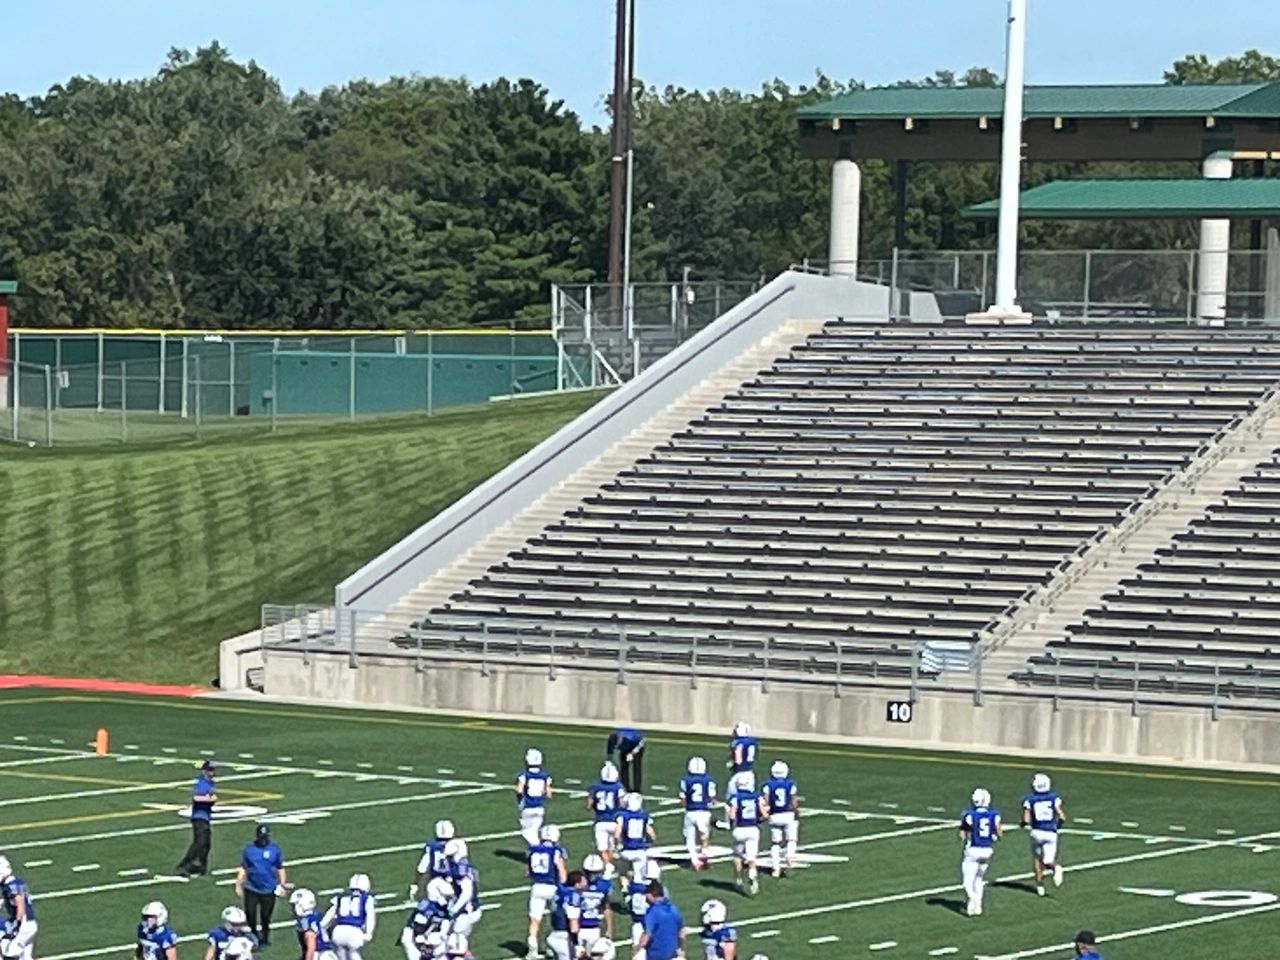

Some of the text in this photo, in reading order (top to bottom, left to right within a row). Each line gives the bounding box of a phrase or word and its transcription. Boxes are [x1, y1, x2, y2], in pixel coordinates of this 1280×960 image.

[889, 703, 911, 722] 10
[691, 783, 703, 803] 2
[775, 788, 787, 808] 3
[979, 817, 991, 838] 5
